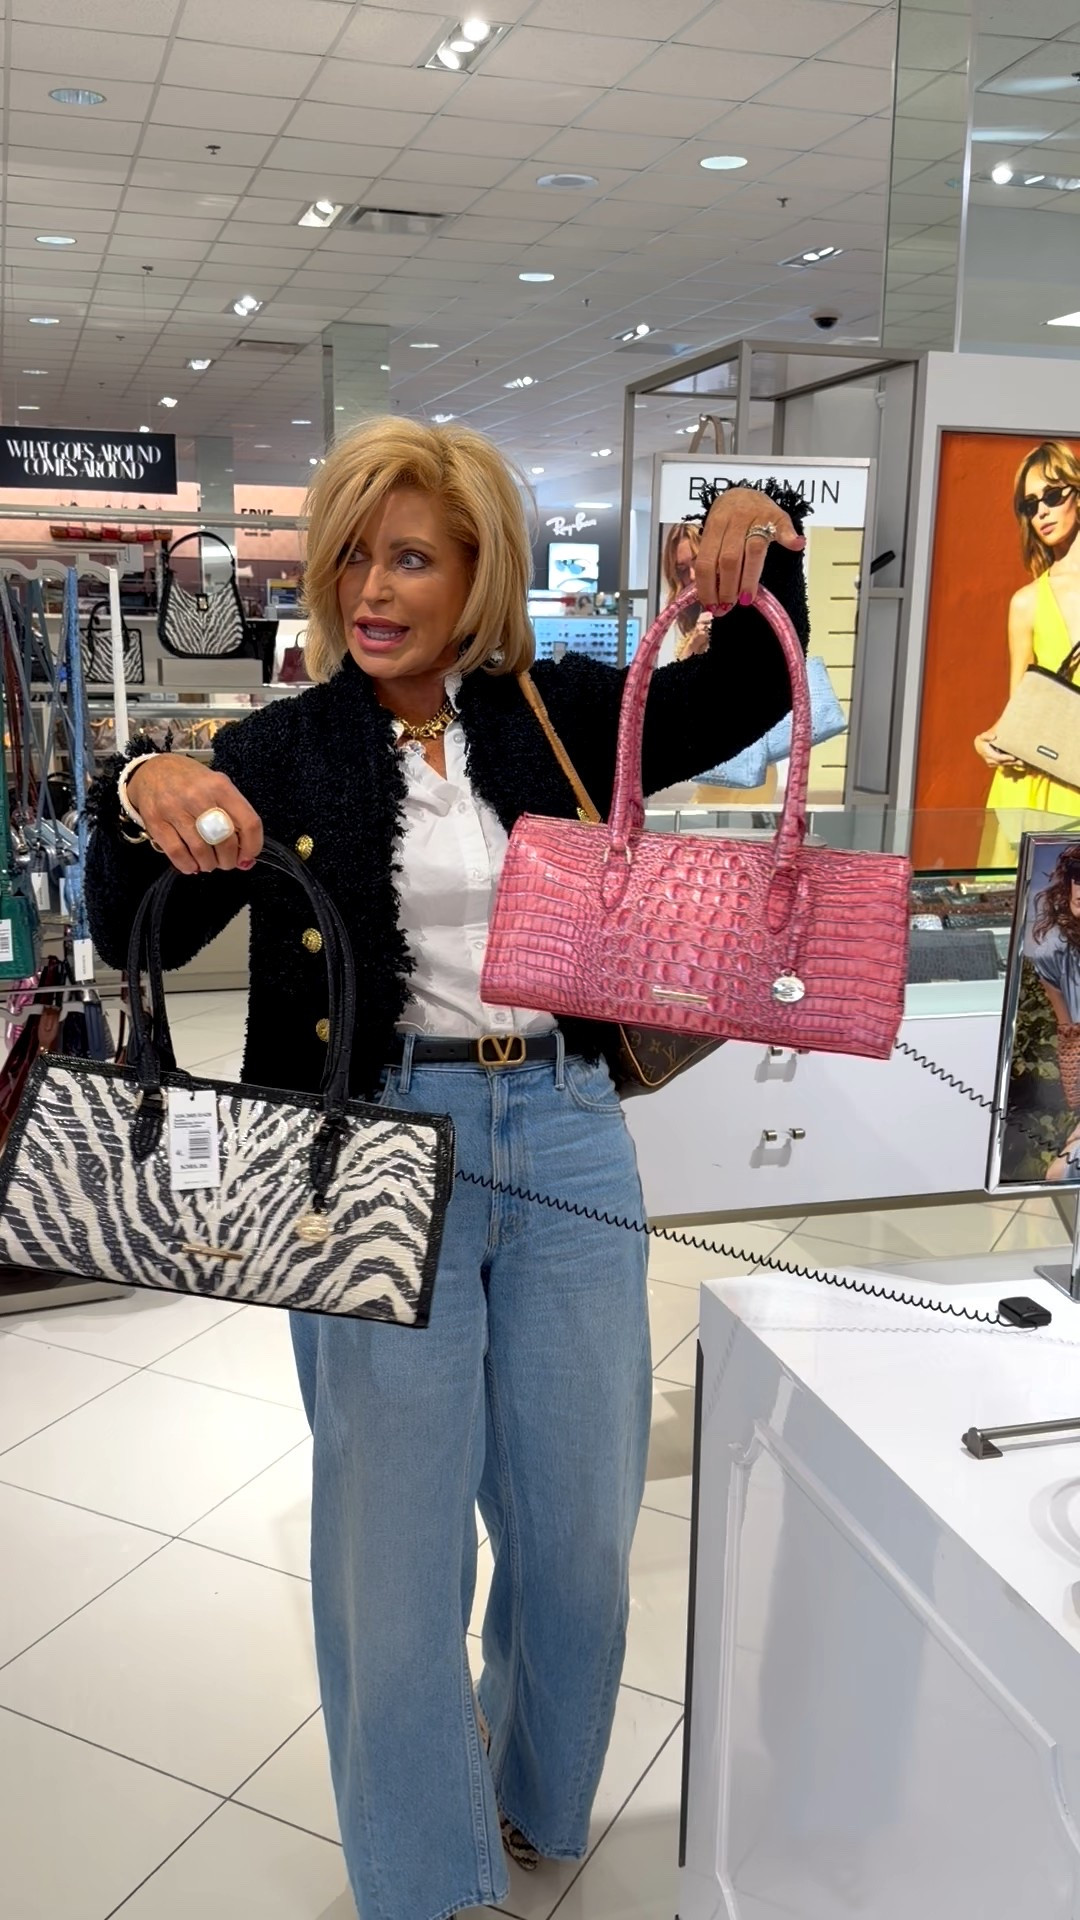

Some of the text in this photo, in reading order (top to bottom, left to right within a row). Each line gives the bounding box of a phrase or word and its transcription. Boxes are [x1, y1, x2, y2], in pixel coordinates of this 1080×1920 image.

[6, 439, 161, 464] WHAT GOES AROUND
[24, 458, 145, 480] COMES AROUND
